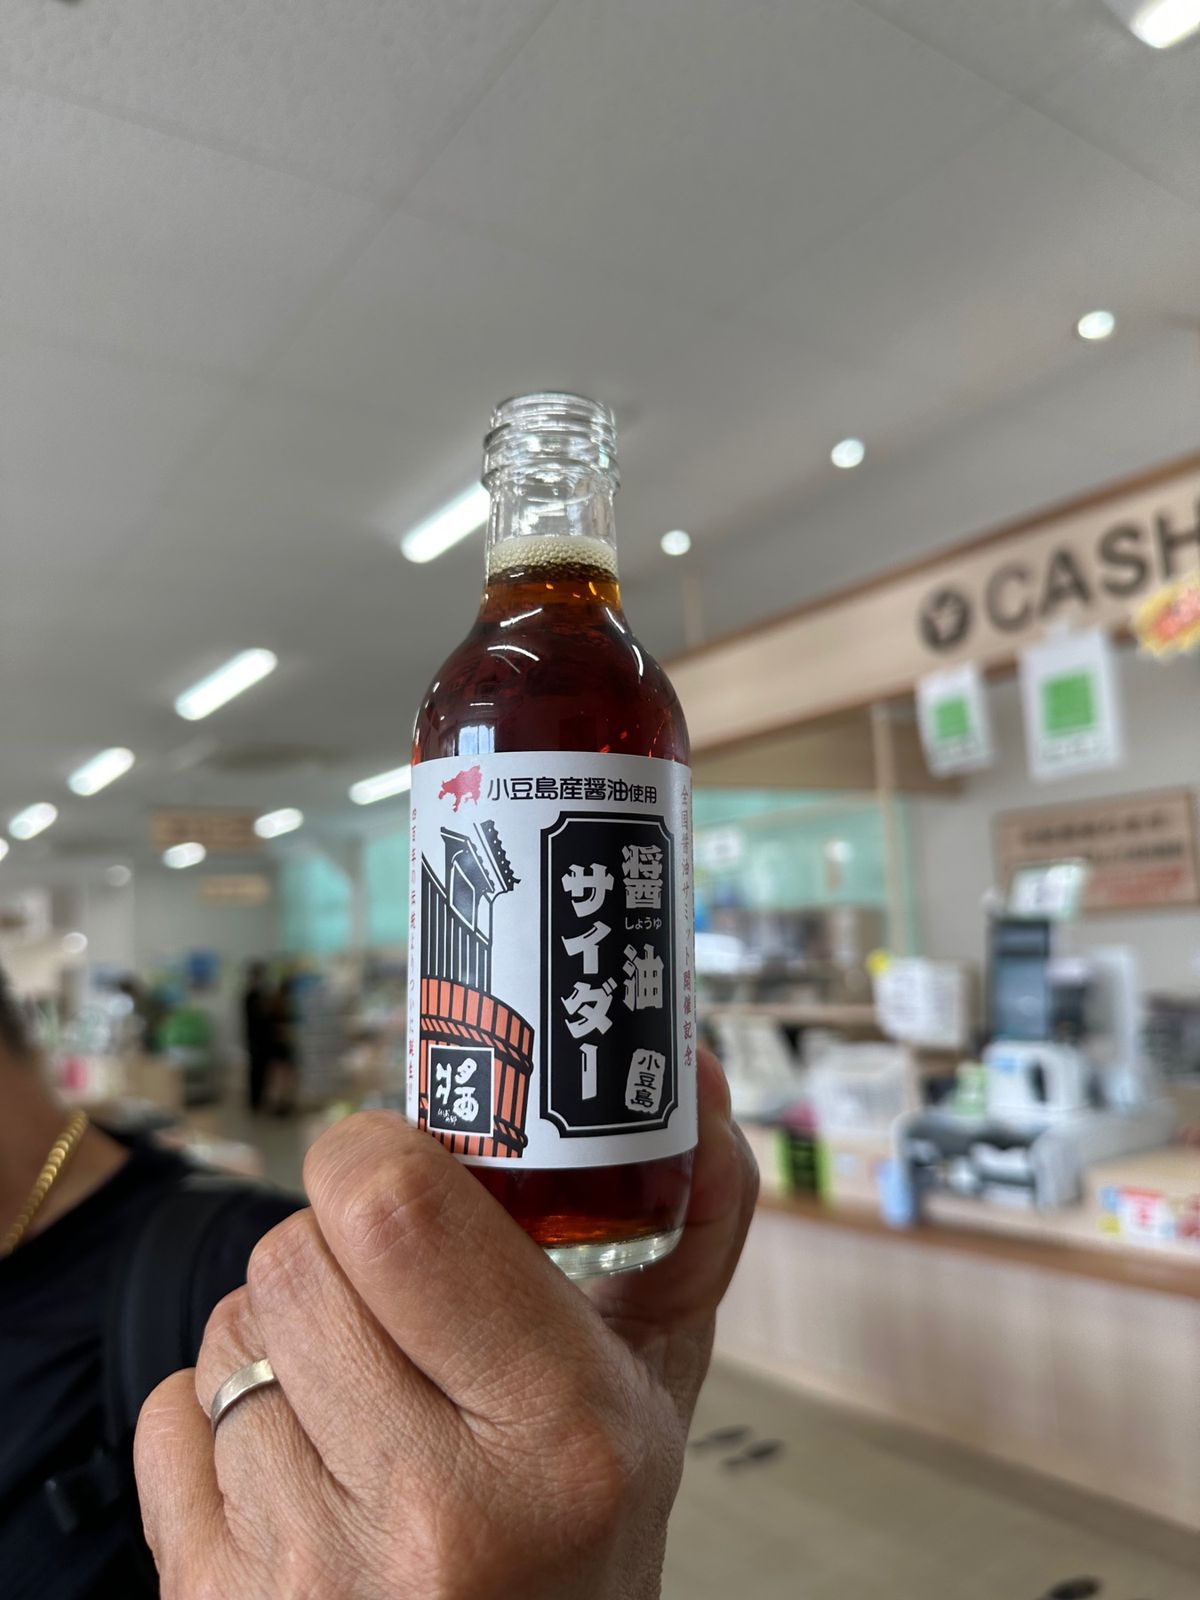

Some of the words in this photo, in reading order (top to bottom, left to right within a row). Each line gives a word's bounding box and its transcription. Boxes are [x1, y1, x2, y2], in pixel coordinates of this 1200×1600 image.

[487, 776, 657, 804] 小豆島産醤油使用
[624, 917, 662, 931] しょうゆ
[560, 862, 618, 1101] サイダー
[630, 1053, 661, 1108] 小豆島
